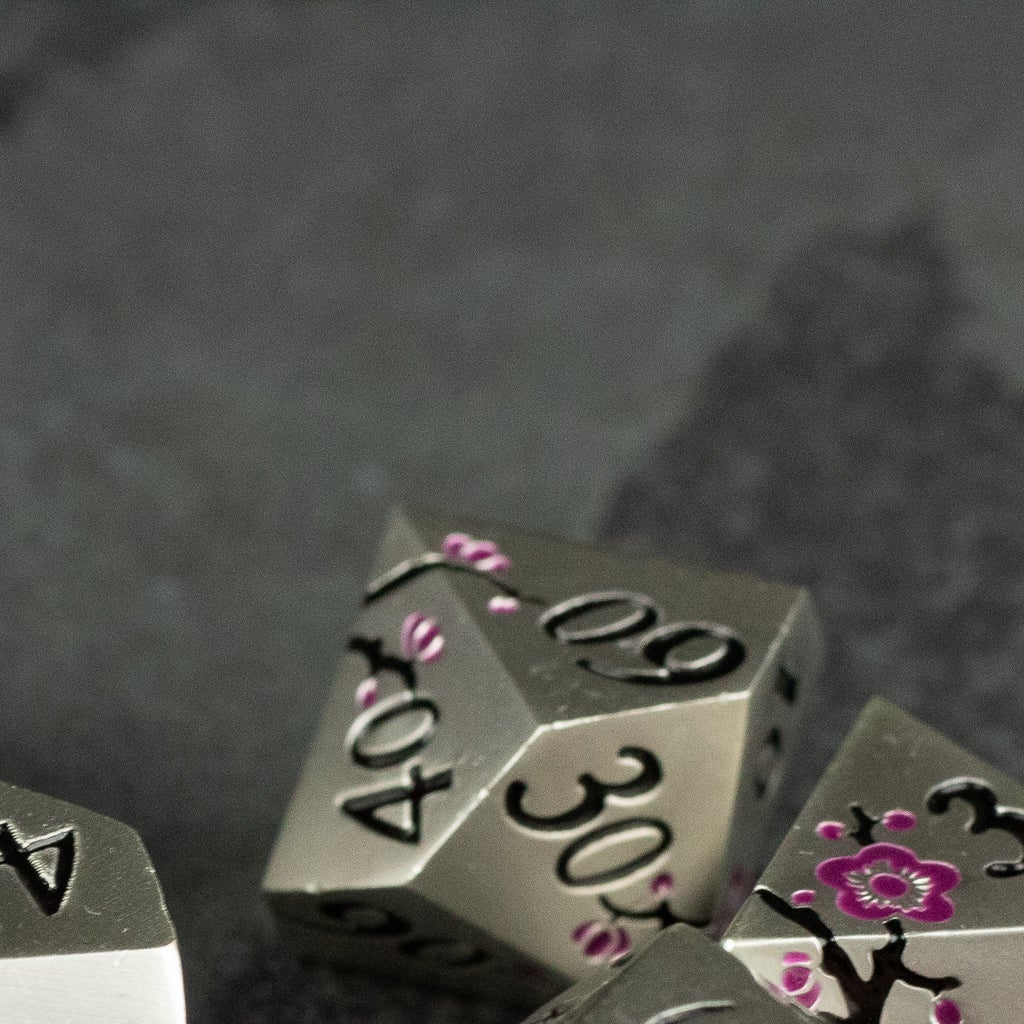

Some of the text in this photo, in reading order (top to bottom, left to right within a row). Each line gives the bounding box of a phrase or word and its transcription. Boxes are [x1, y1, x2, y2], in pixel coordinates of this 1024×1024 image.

[335, 692, 453, 845] 40
[504, 746, 673, 893] 30
[927, 778, 1024, 878] 3
